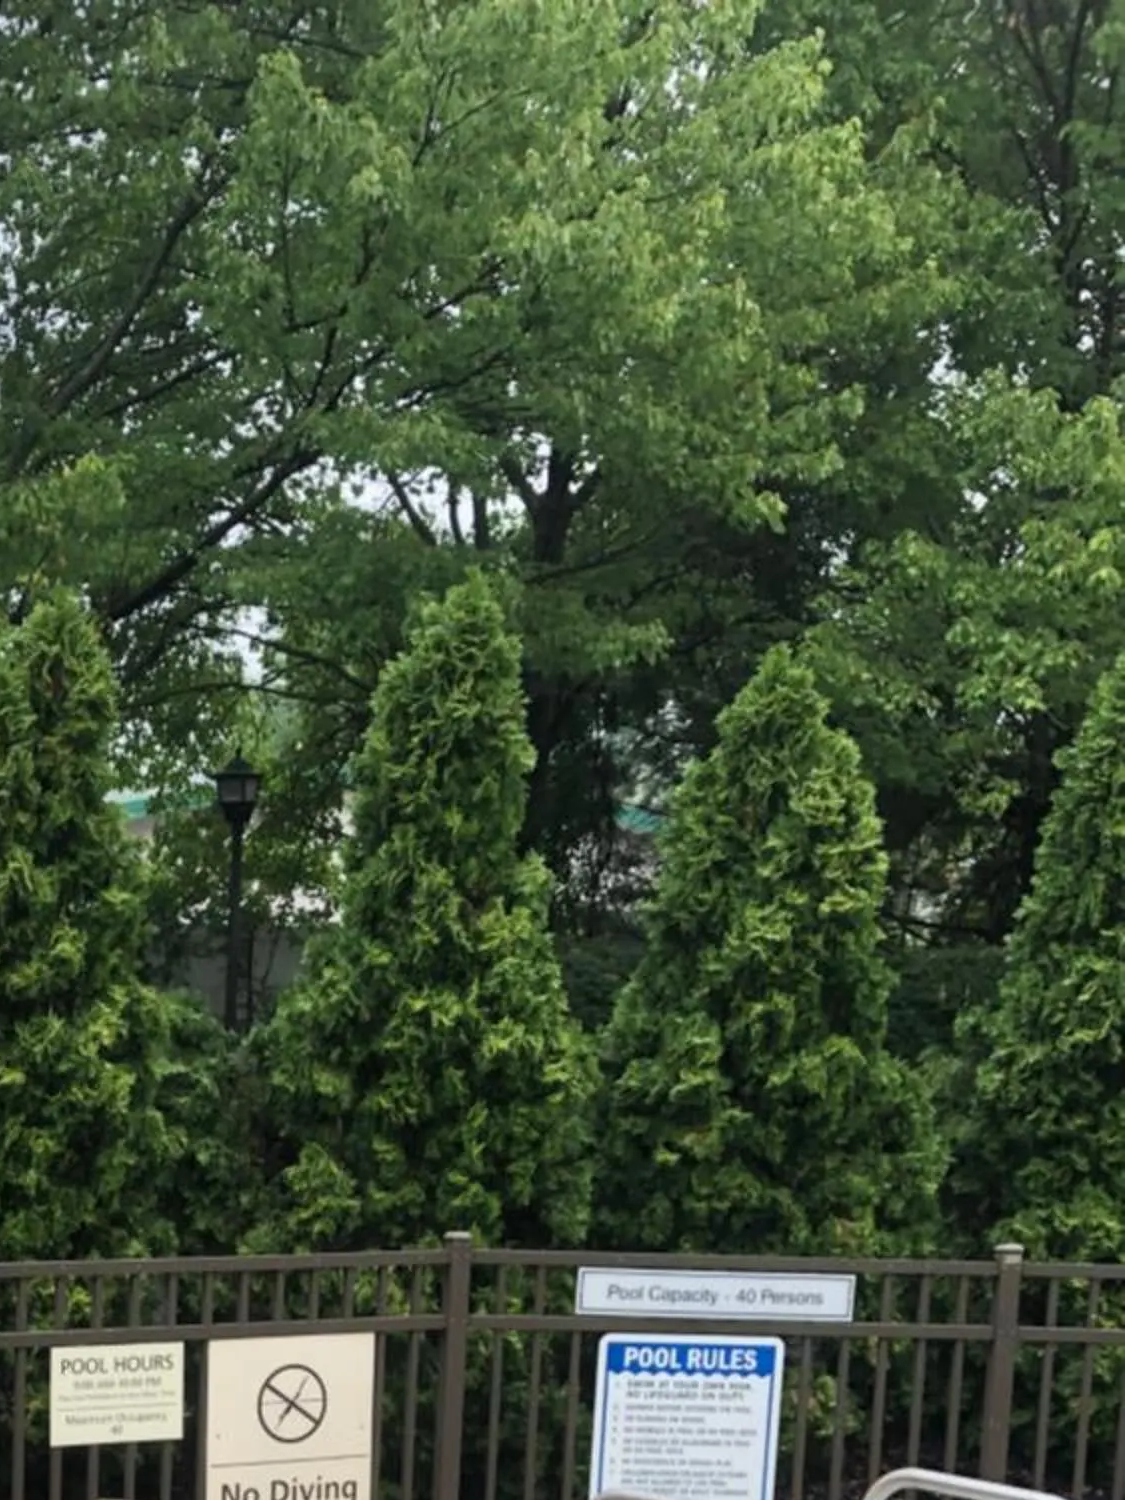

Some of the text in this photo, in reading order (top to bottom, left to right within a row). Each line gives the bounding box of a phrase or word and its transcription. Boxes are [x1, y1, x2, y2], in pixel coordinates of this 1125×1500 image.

[606, 1284, 644, 1301] Pool
[648, 1286, 718, 1306] Capacity
[734, 1288, 757, 1303] 40
[761, 1289, 825, 1306] Persons
[60, 1354, 174, 1375] POOL HOURS
[623, 1346, 758, 1370] POOL RULES
